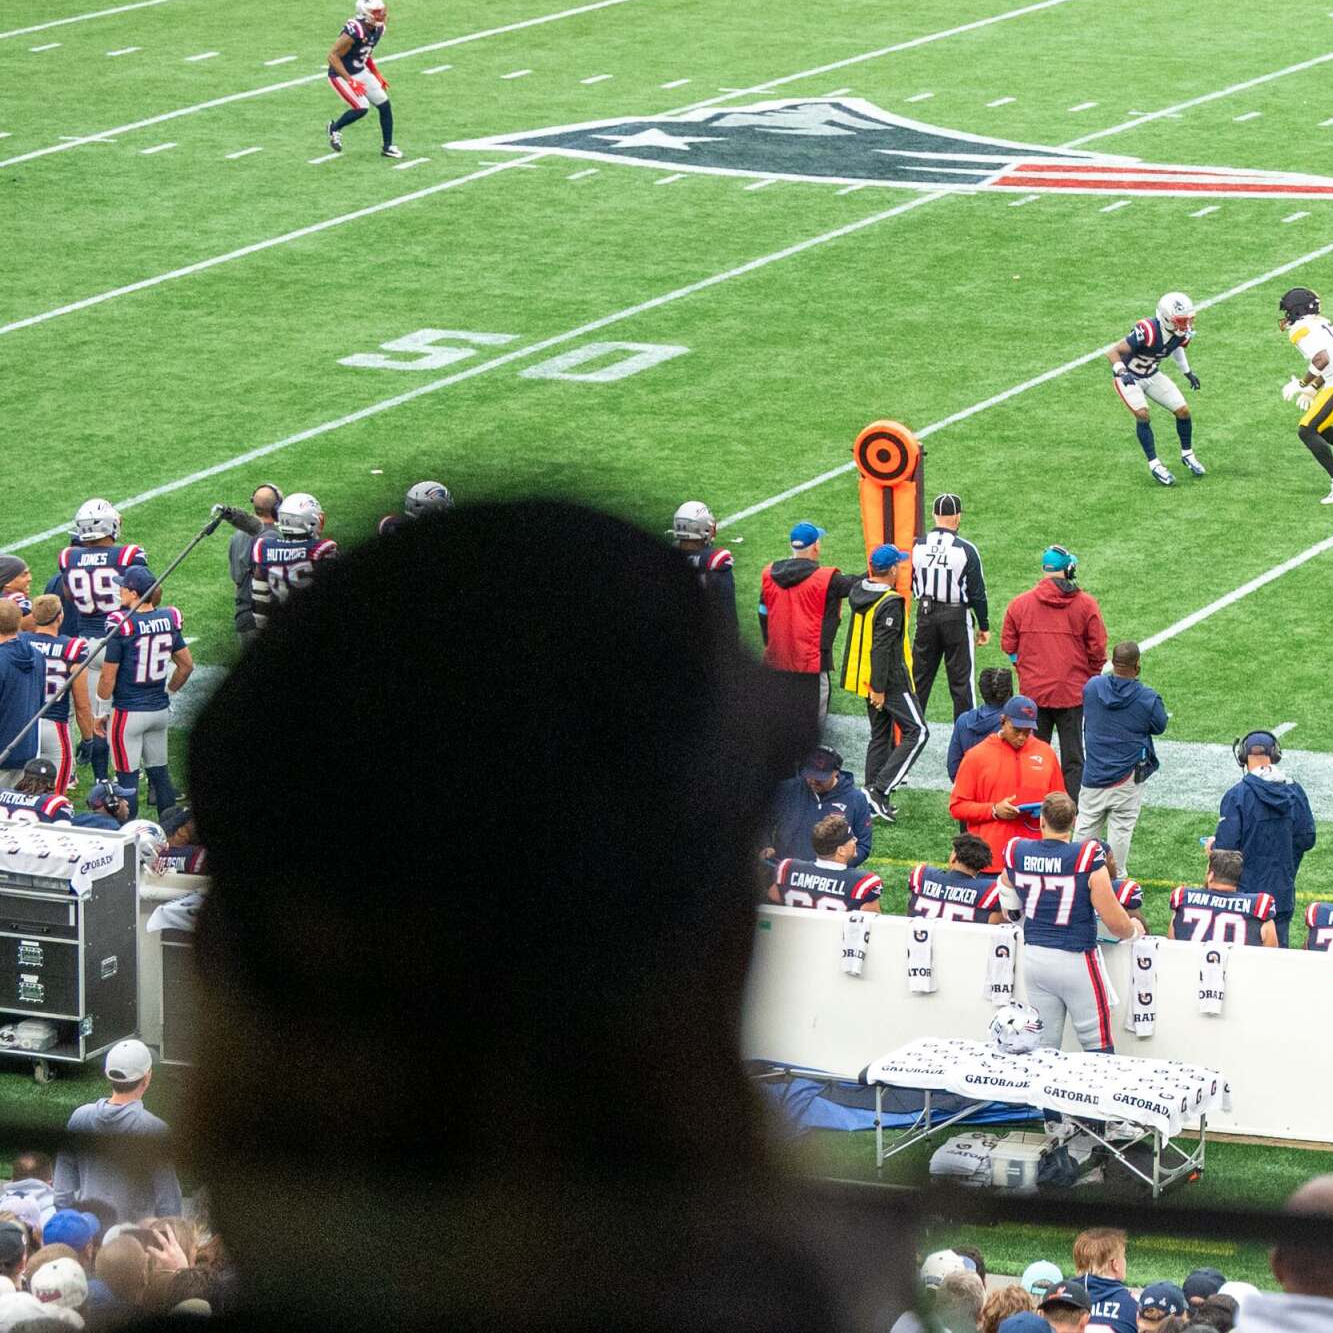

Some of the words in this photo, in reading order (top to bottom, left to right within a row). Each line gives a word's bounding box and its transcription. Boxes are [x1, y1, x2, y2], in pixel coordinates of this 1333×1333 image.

[337, 328, 690, 382] 50
[77, 553, 108, 567] JONES
[925, 553, 949, 568] 74
[66, 568, 122, 614] 99
[138, 617, 172, 635] DeVITO
[134, 635, 171, 683] 16
[1024, 855, 1062, 873] BROWN
[790, 872, 846, 896] CAMPBELL
[922, 880, 977, 903] VERA-TUCKER
[1016, 873, 1076, 926] 77
[1187, 891, 1211, 907] VAN
[1215, 893, 1251, 913] ROTEN
[1112, 1092, 1171, 1118] GATORAD
